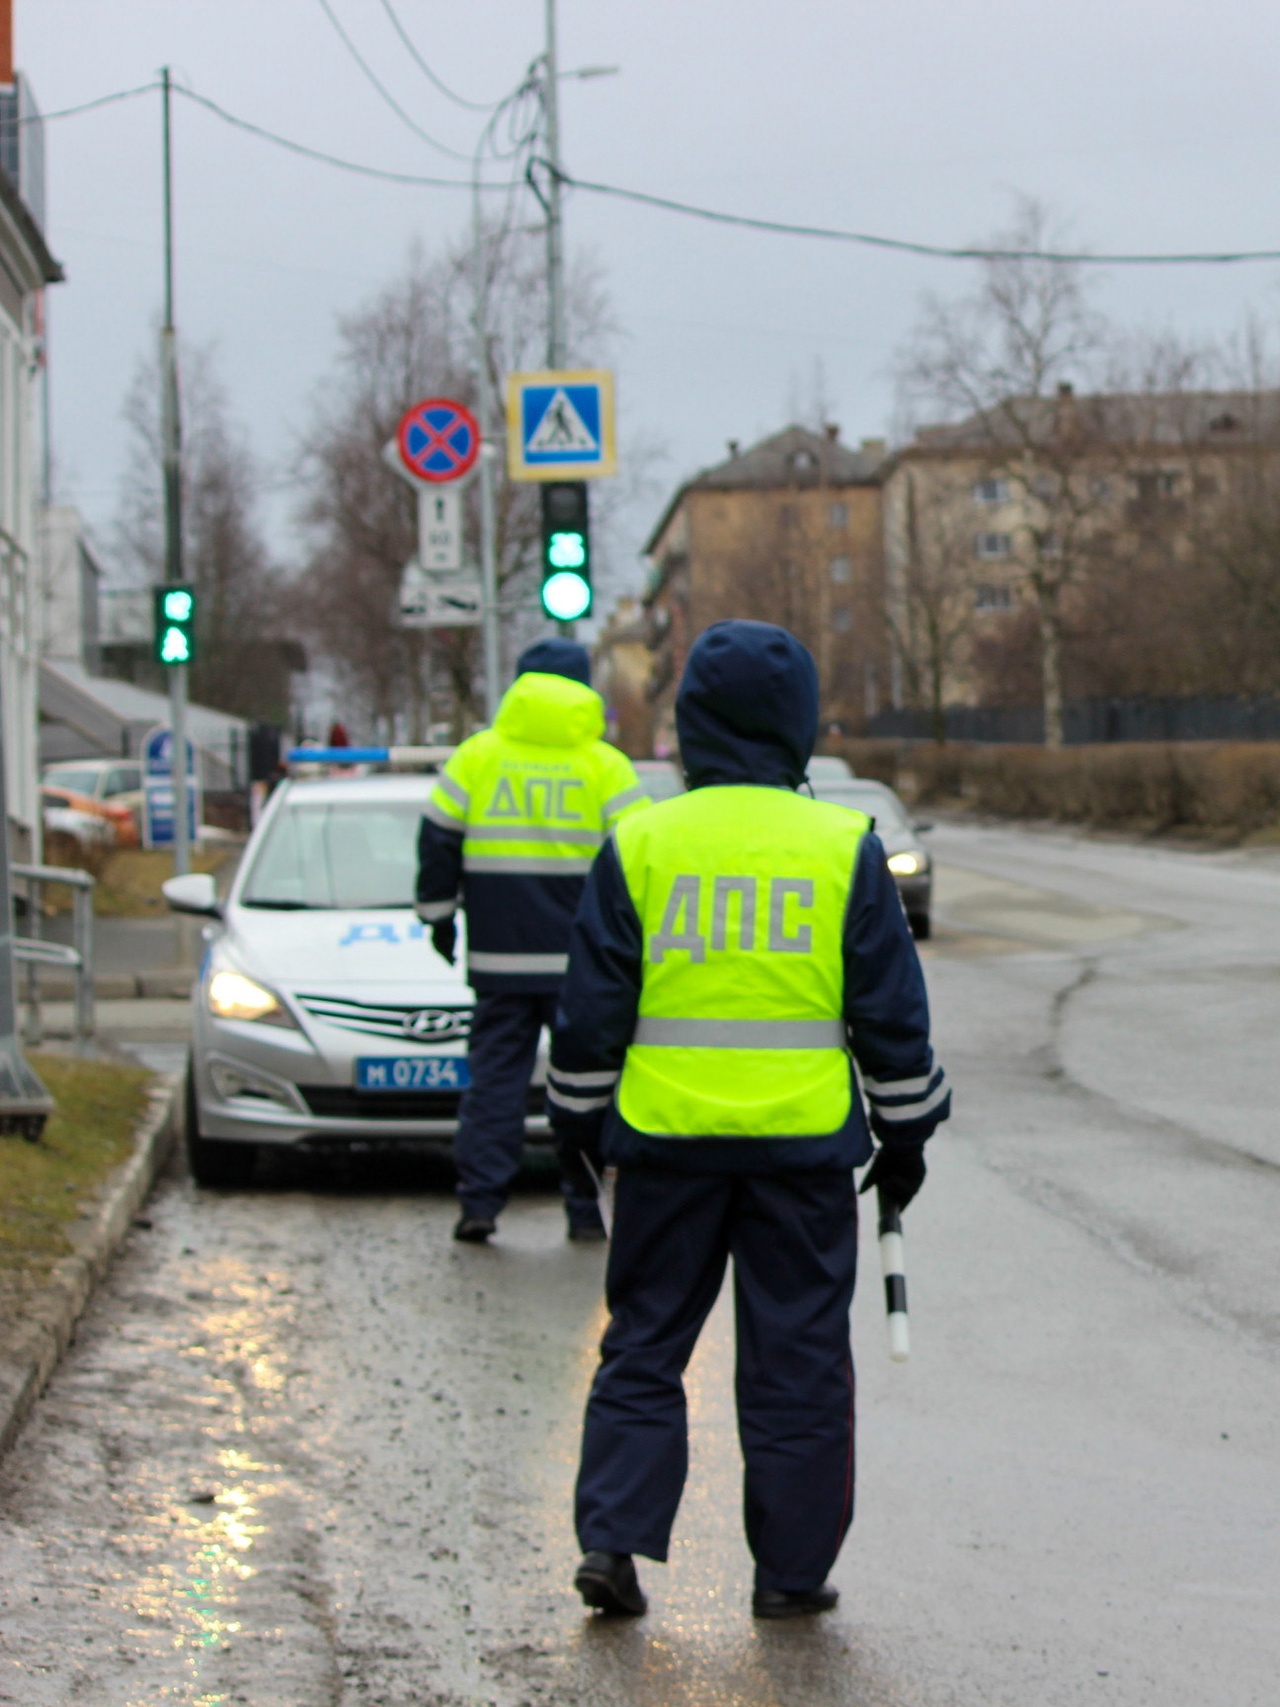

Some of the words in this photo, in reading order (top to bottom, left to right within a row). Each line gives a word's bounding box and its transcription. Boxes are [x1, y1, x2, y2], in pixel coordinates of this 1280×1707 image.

[486, 777, 583, 821] ДПС
[650, 874, 814, 964] ДПС
[393, 1059, 458, 1086] 0734
